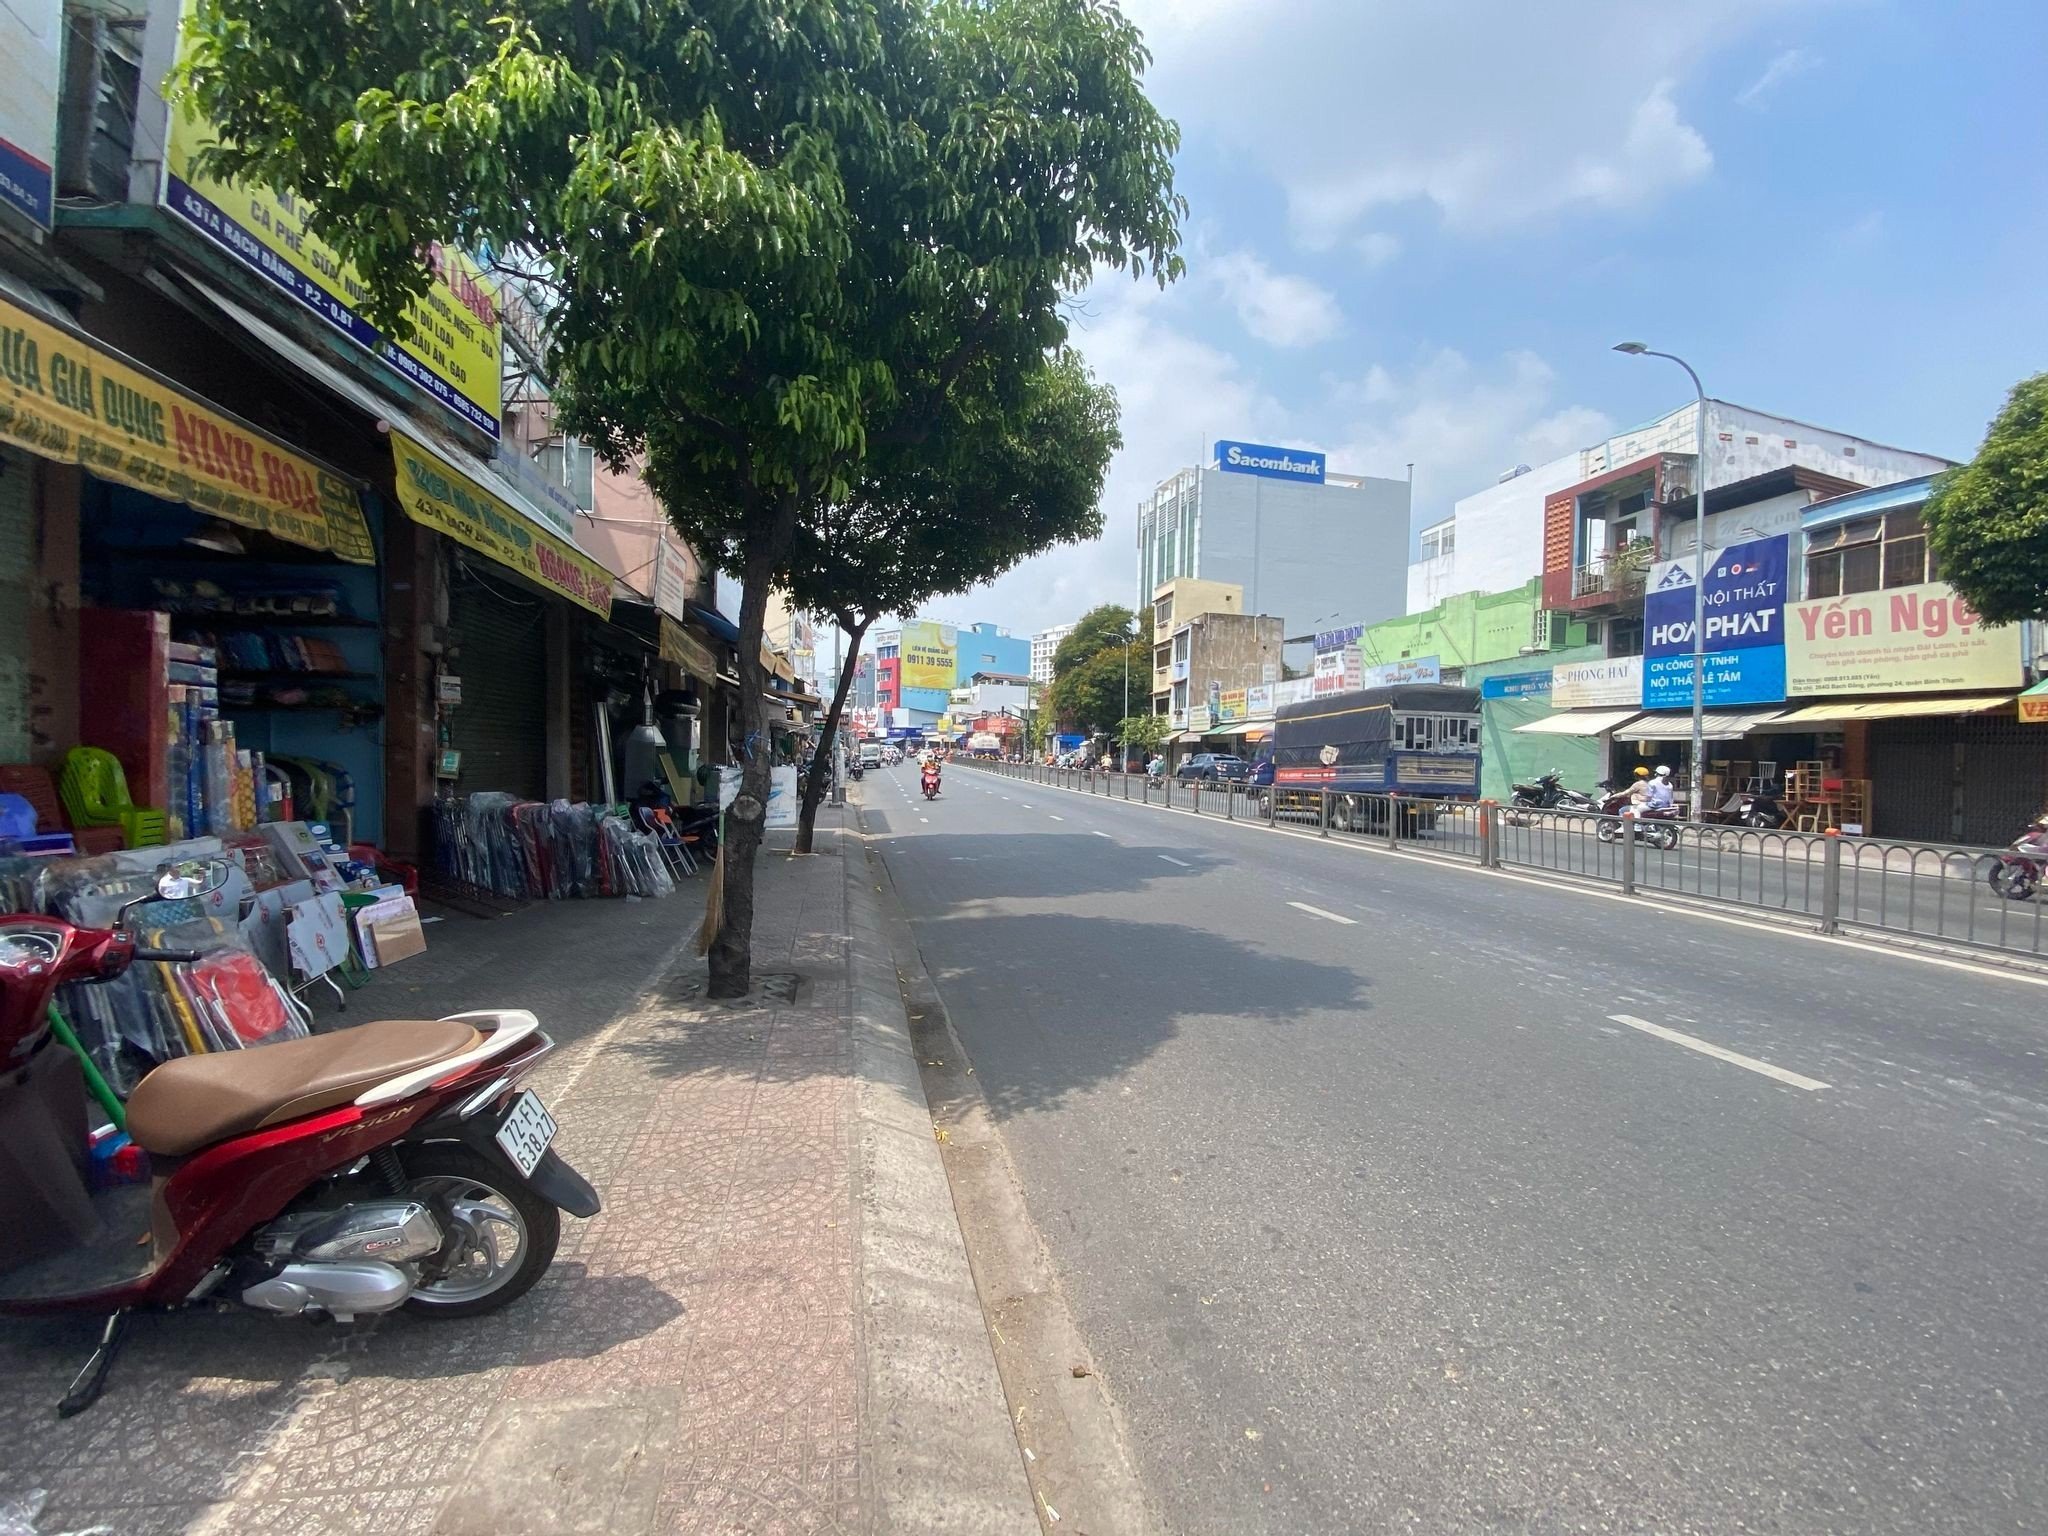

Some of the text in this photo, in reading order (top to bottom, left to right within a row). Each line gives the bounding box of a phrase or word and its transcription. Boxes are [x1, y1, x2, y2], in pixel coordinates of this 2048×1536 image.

[223, 222, 260, 261] BẠCH
[449, 360, 467, 384] GẠO
[51, 351, 97, 419] GIA
[102, 376, 168, 449] DỤNG
[171, 405, 261, 494] NINH
[1227, 446, 1320, 475] Sacombank
[1703, 579, 1777, 607] NỘI THẤT
[1705, 608, 1776, 639] PHÁT
[1798, 592, 1979, 641] Yến Ngọ
[907, 654, 953, 668] 0911 39 5555
[921, 646, 927, 654] HỆ
[1838, 650, 1855, 658] kinh
[1856, 648, 1881, 657] doanh
[1568, 668, 1605, 683] PHONG
[1650, 664, 1664, 672] CN
[1665, 659, 1694, 671] CÔNG
[1710, 655, 1739, 666] TNHH
[1504, 685, 1519, 693] KHU
[1650, 675, 1669, 690] NỘI
[1702, 671, 1714, 684] LÊ
[1716, 670, 1741, 683] TÂM
[319, 1104, 417, 1142] VISION
[516, 1112, 553, 1171] 638.27
